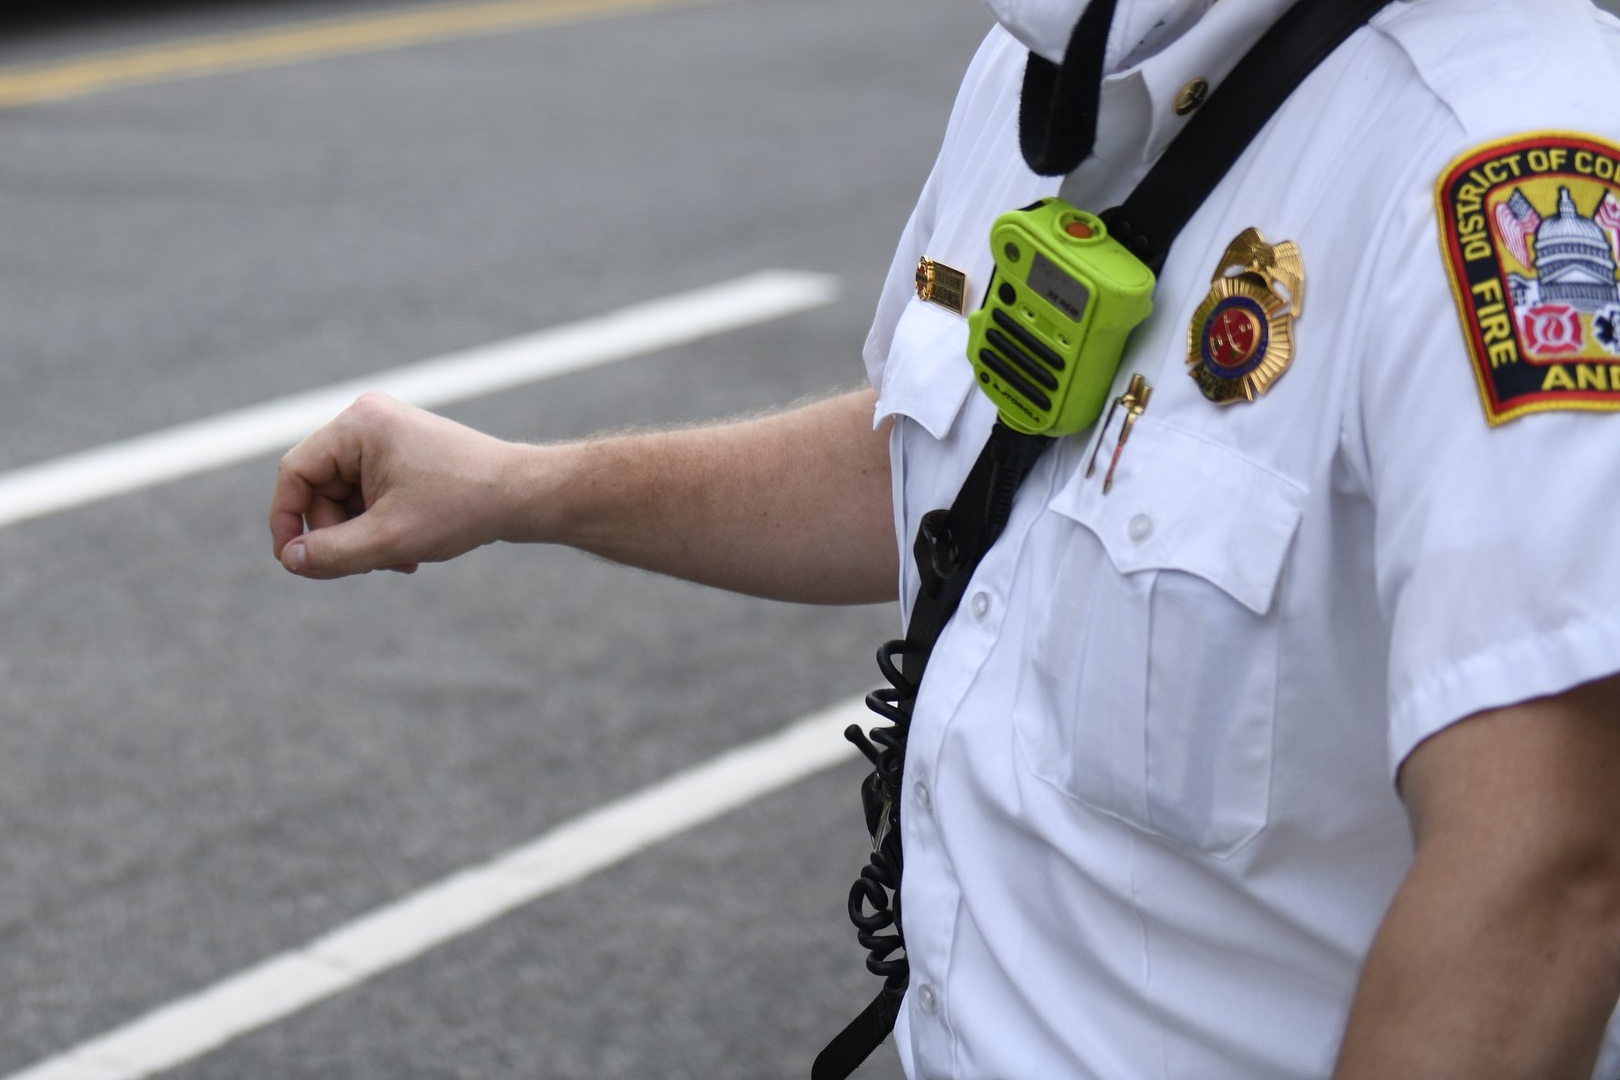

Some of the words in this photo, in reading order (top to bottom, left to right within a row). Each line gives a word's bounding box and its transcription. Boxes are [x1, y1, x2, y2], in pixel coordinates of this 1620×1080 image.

[1456, 154, 1521, 262] DISTRICT
[1527, 148, 1567, 172] OF
[1472, 277, 1518, 368] FIRE
